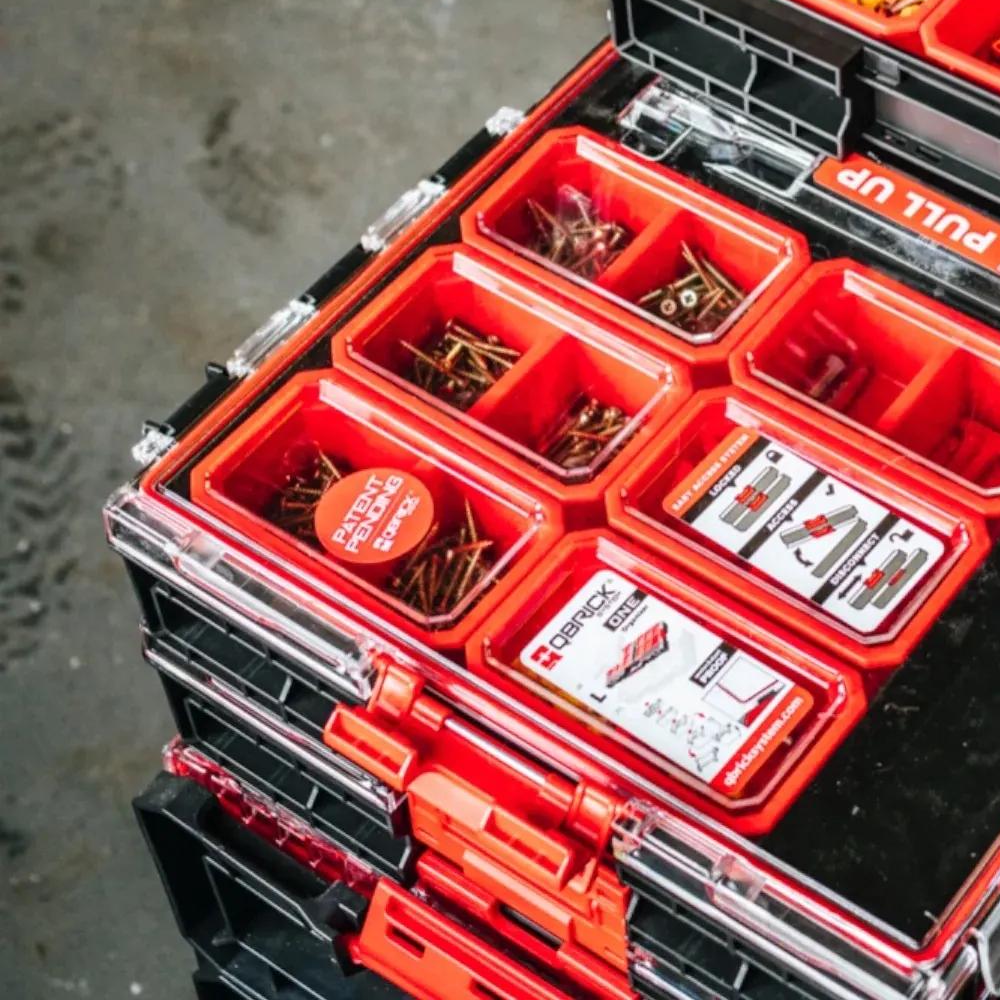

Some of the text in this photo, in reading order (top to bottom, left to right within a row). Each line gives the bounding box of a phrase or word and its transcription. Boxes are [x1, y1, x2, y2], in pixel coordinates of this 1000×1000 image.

[836, 168, 998, 254] PULL UP
[331, 474, 384, 545] PATENT
[708, 464, 742, 497] LOCKED
[344, 475, 405, 554] PENDING
[767, 499, 798, 532] ACCESS
[830, 531, 881, 586] DISCONNECT
[549, 584, 616, 650] QBRICK
[607, 594, 640, 628] ONE
[723, 696, 805, 787] qbricksystem.com
